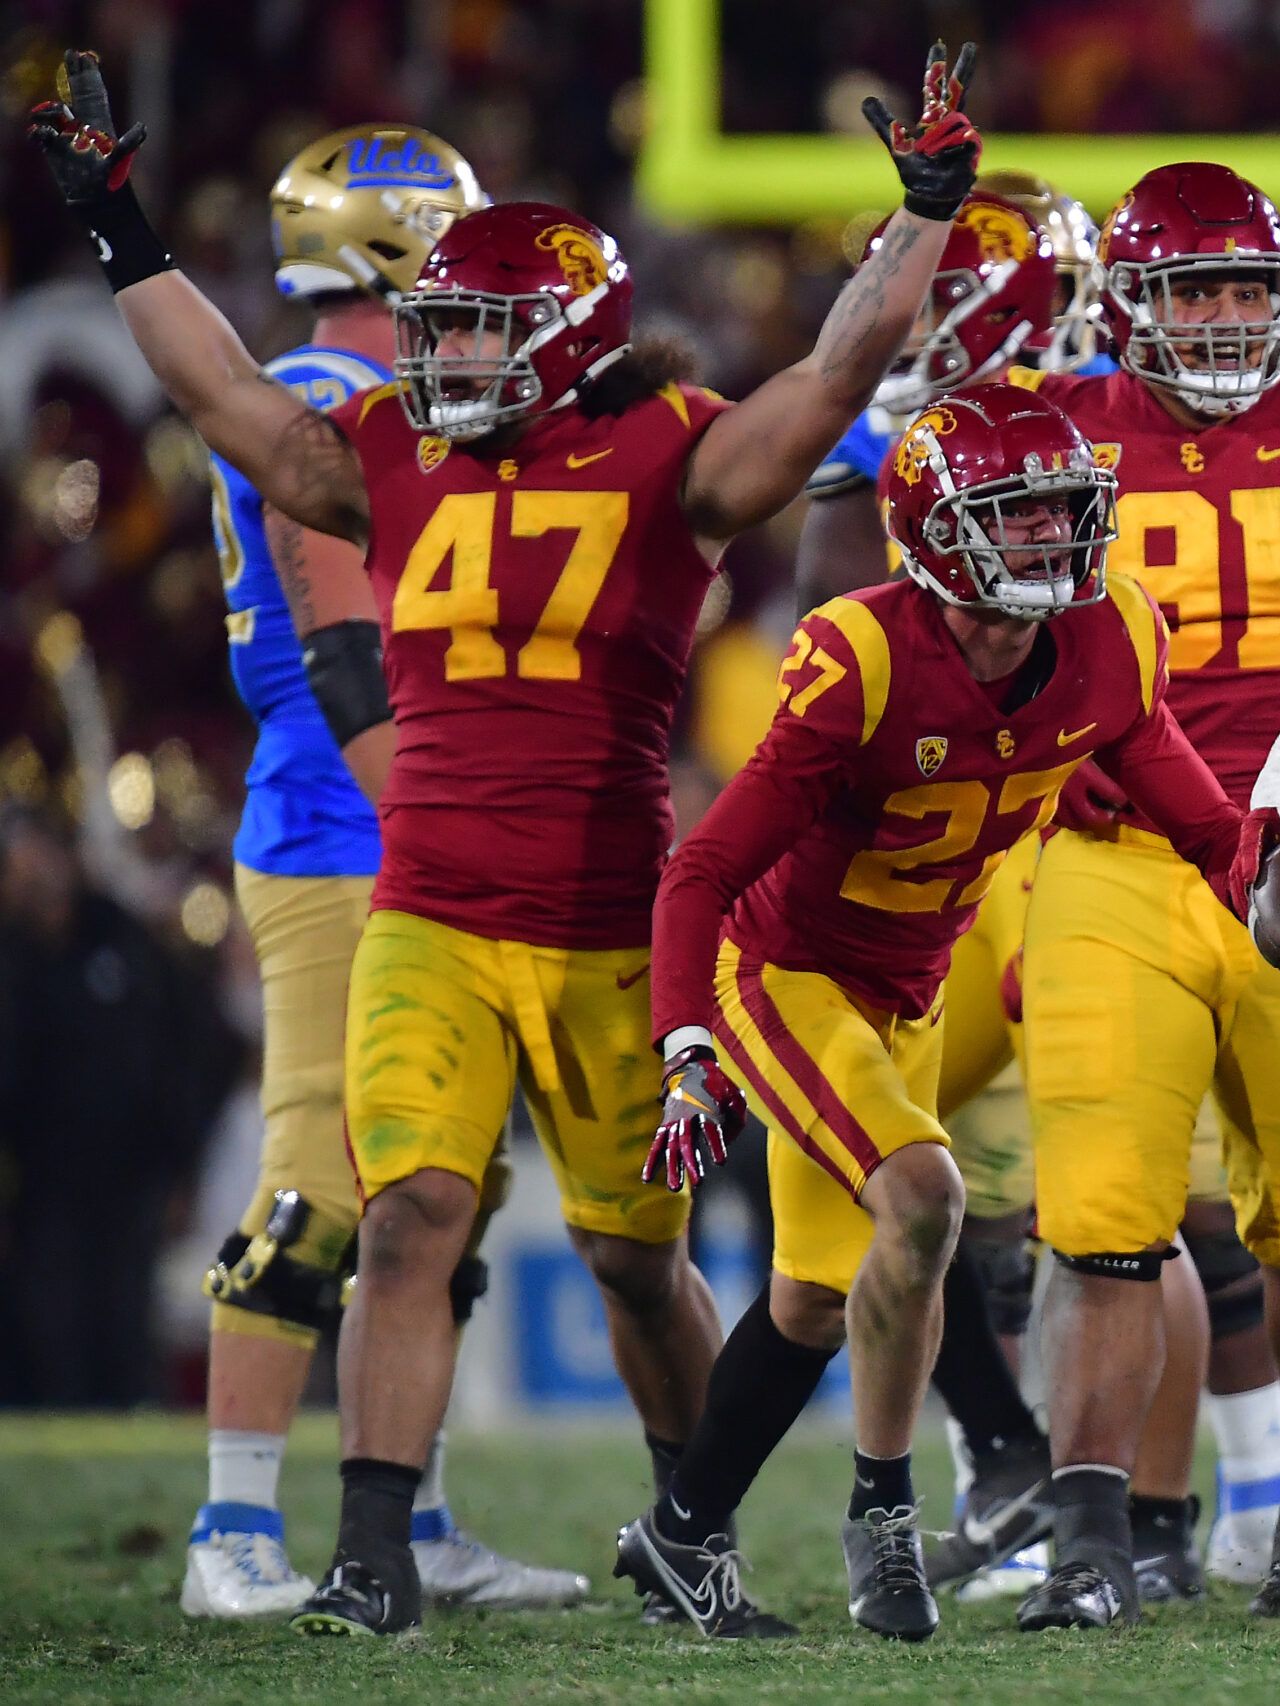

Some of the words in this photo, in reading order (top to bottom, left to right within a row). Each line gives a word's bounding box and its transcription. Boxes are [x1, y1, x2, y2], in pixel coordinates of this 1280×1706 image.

[393, 490, 630, 682] 47
[776, 628, 848, 718] 27
[923, 755, 937, 769] 12
[839, 751, 1093, 914] 27
